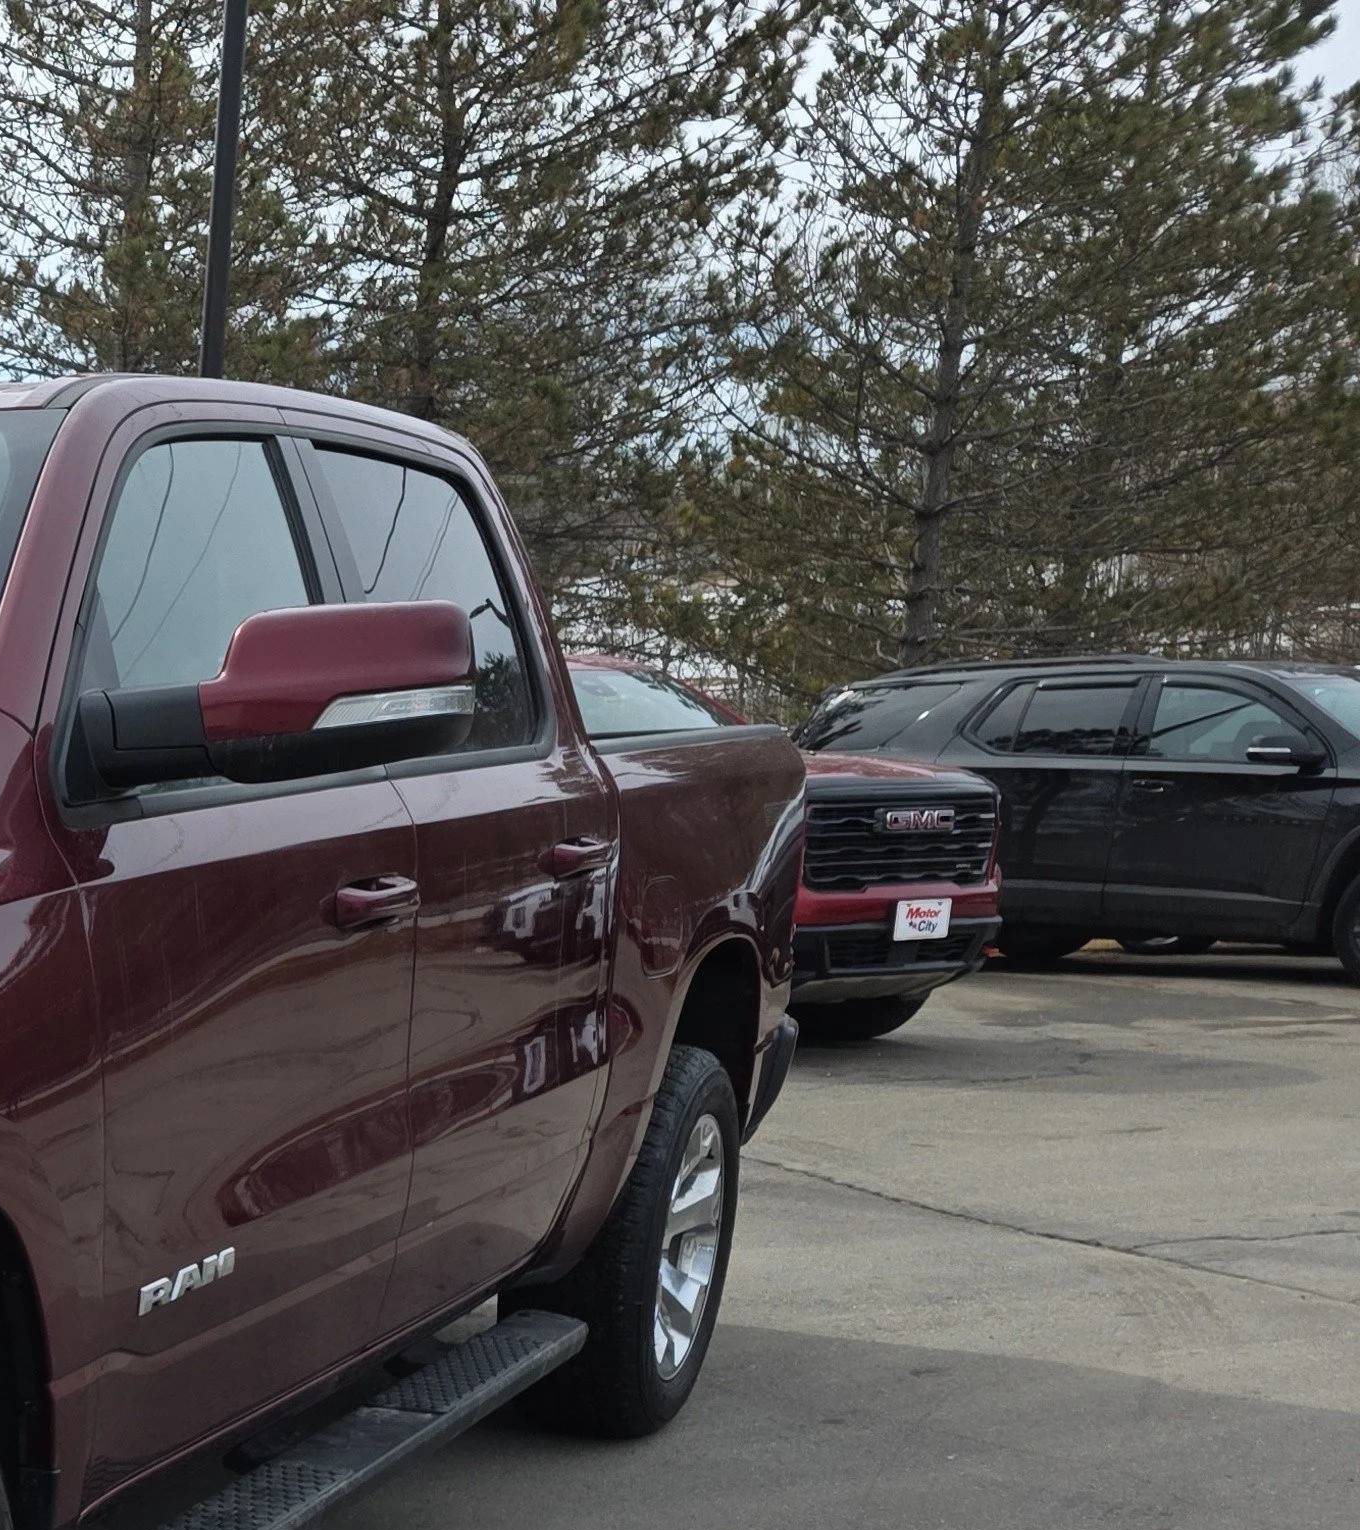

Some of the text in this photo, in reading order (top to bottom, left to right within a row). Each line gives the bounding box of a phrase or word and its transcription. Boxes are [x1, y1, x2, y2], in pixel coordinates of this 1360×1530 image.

[885, 808, 955, 831] GMC
[905, 906, 942, 920] Motor
[917, 920, 939, 934] City
[138, 1246, 235, 1317] RAM
